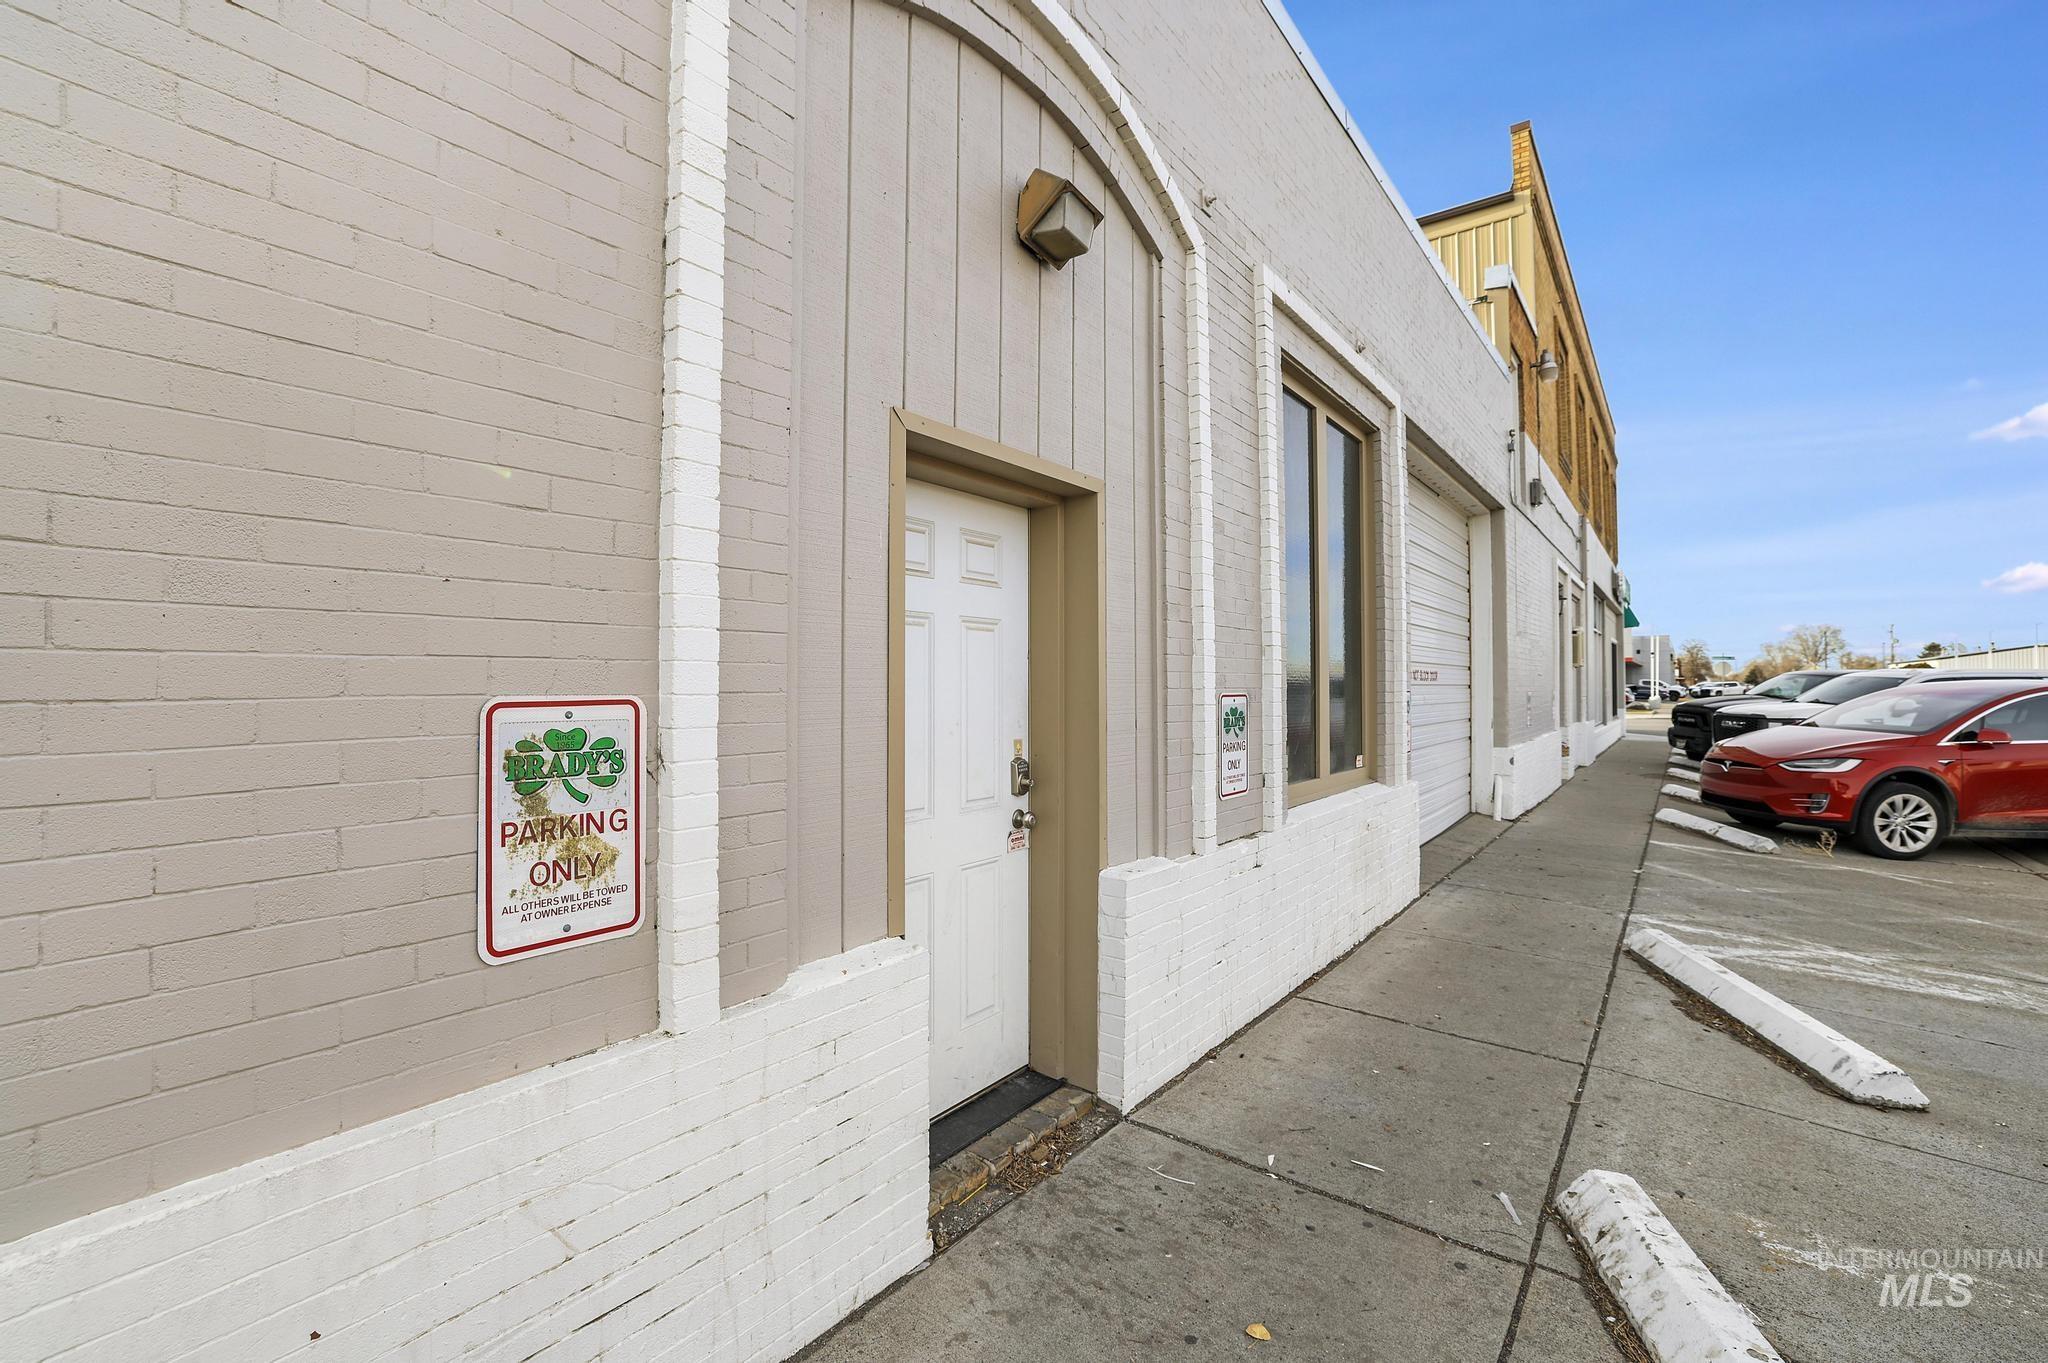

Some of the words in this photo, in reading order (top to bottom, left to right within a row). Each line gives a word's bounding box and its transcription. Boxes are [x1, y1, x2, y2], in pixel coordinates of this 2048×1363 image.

[554, 733, 576, 741] Since
[556, 741, 575, 750] 1965
[1223, 741, 1246, 753] PARKING
[505, 749, 625, 782] BRADY'S
[1227, 759, 1241, 770] ONLY
[501, 808, 628, 847] PARKING
[530, 853, 602, 886] ONLY
[501, 905, 520, 916] ALL
[521, 896, 559, 912] OTHERS
[560, 893, 581, 904] WILL
[583, 890, 595, 900] BE
[597, 884, 628, 897] TOWED
[521, 913, 532, 923] AT
[534, 905, 570, 920] OWNER
[571, 897, 612, 912] EXPENSE
